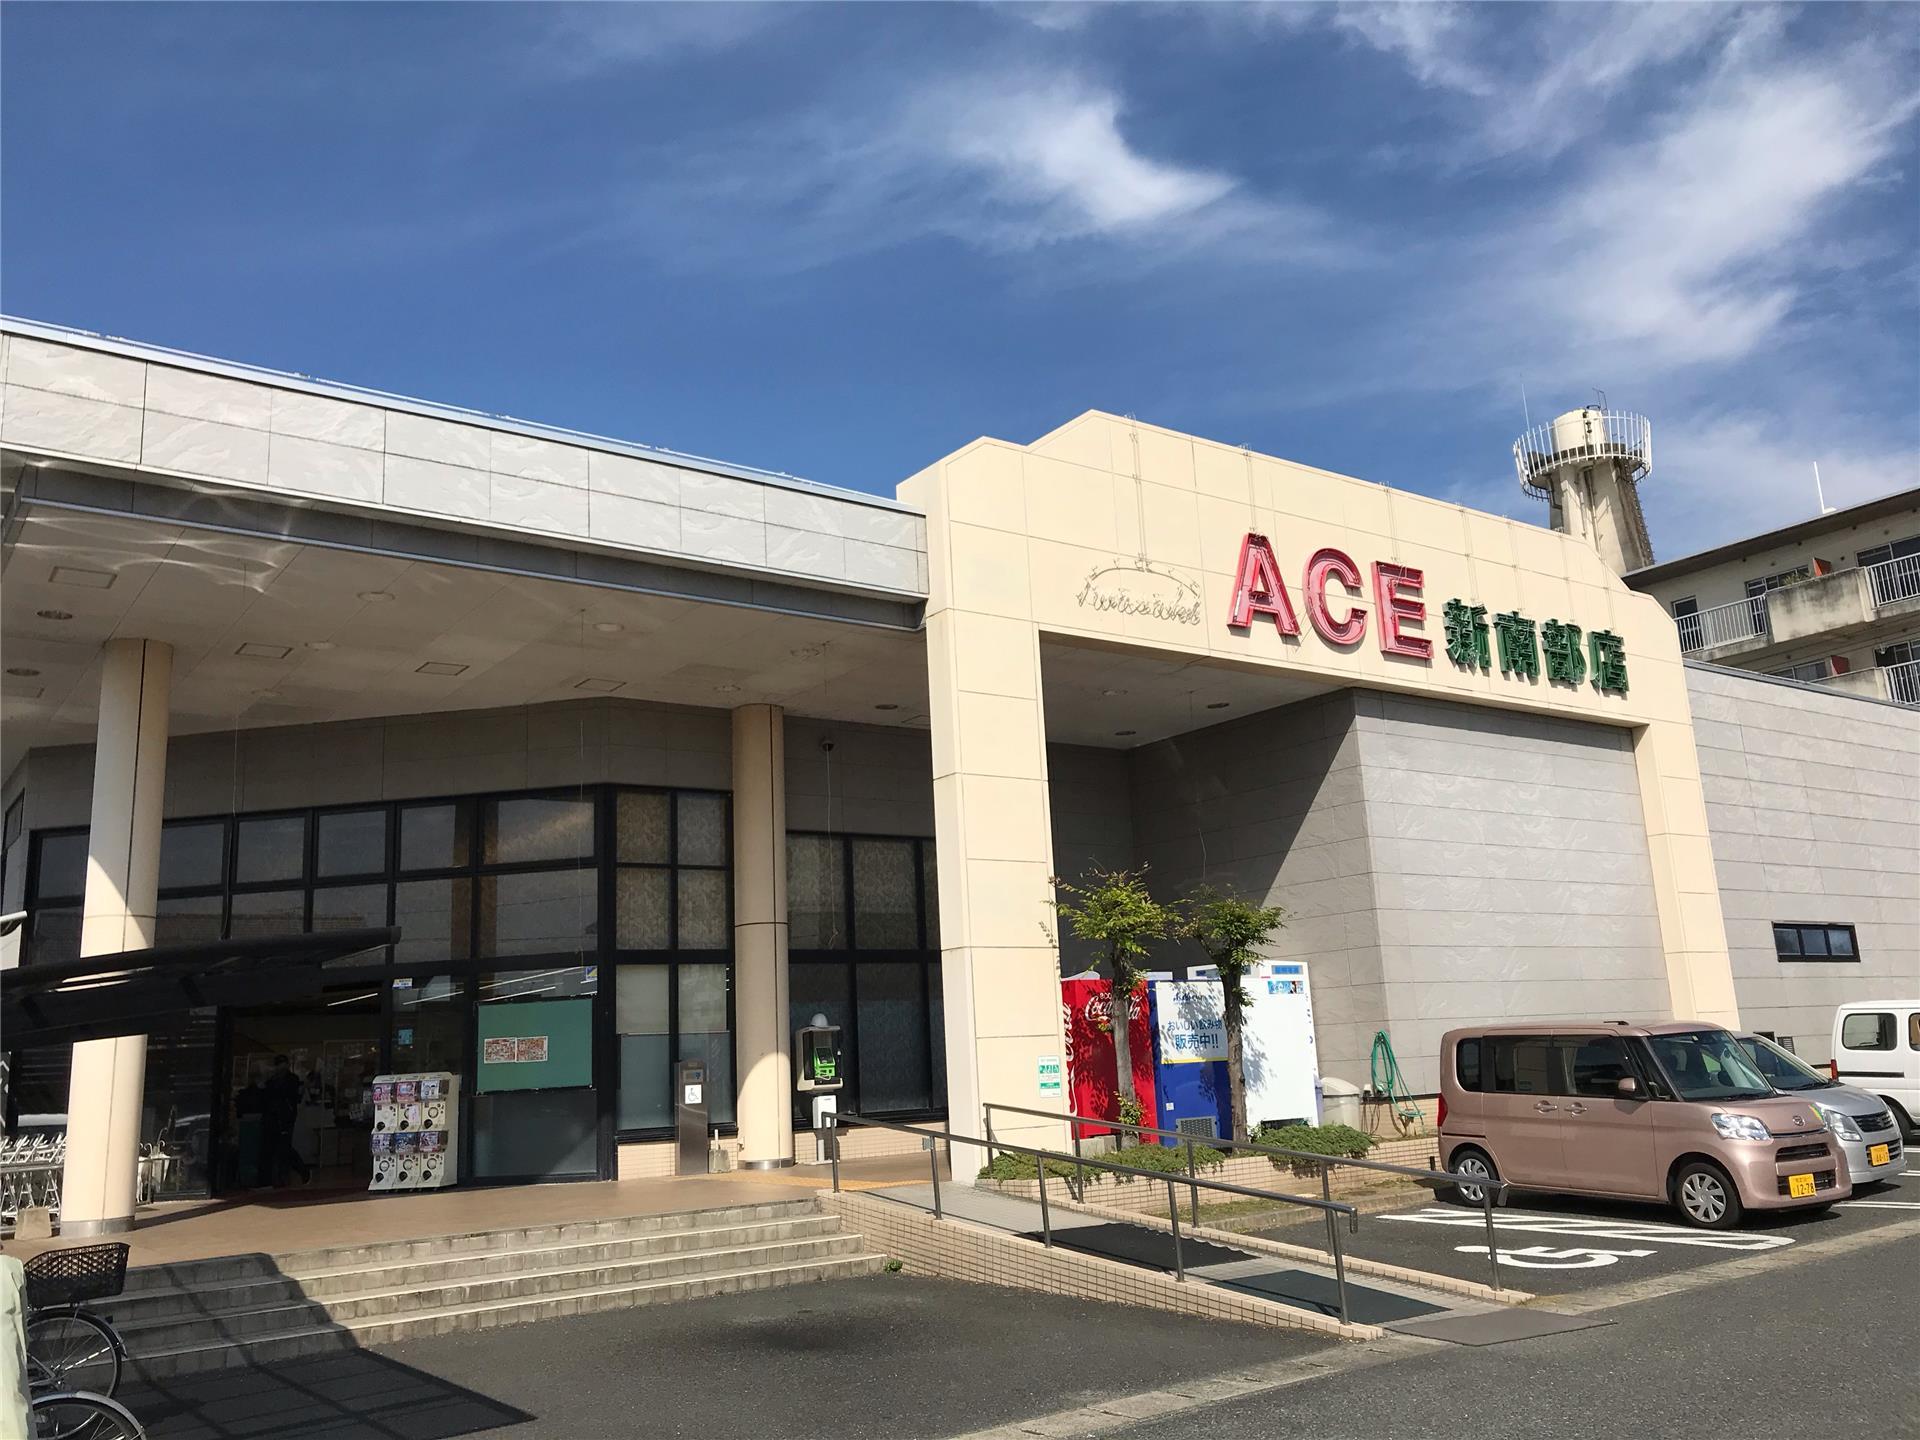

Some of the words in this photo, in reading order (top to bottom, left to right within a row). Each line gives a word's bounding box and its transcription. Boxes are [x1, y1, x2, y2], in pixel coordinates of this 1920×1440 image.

[1227, 532, 1434, 659] ACE
[1442, 598, 1630, 692] 新南部店
[1796, 1182, 1815, 1196] 12-78
